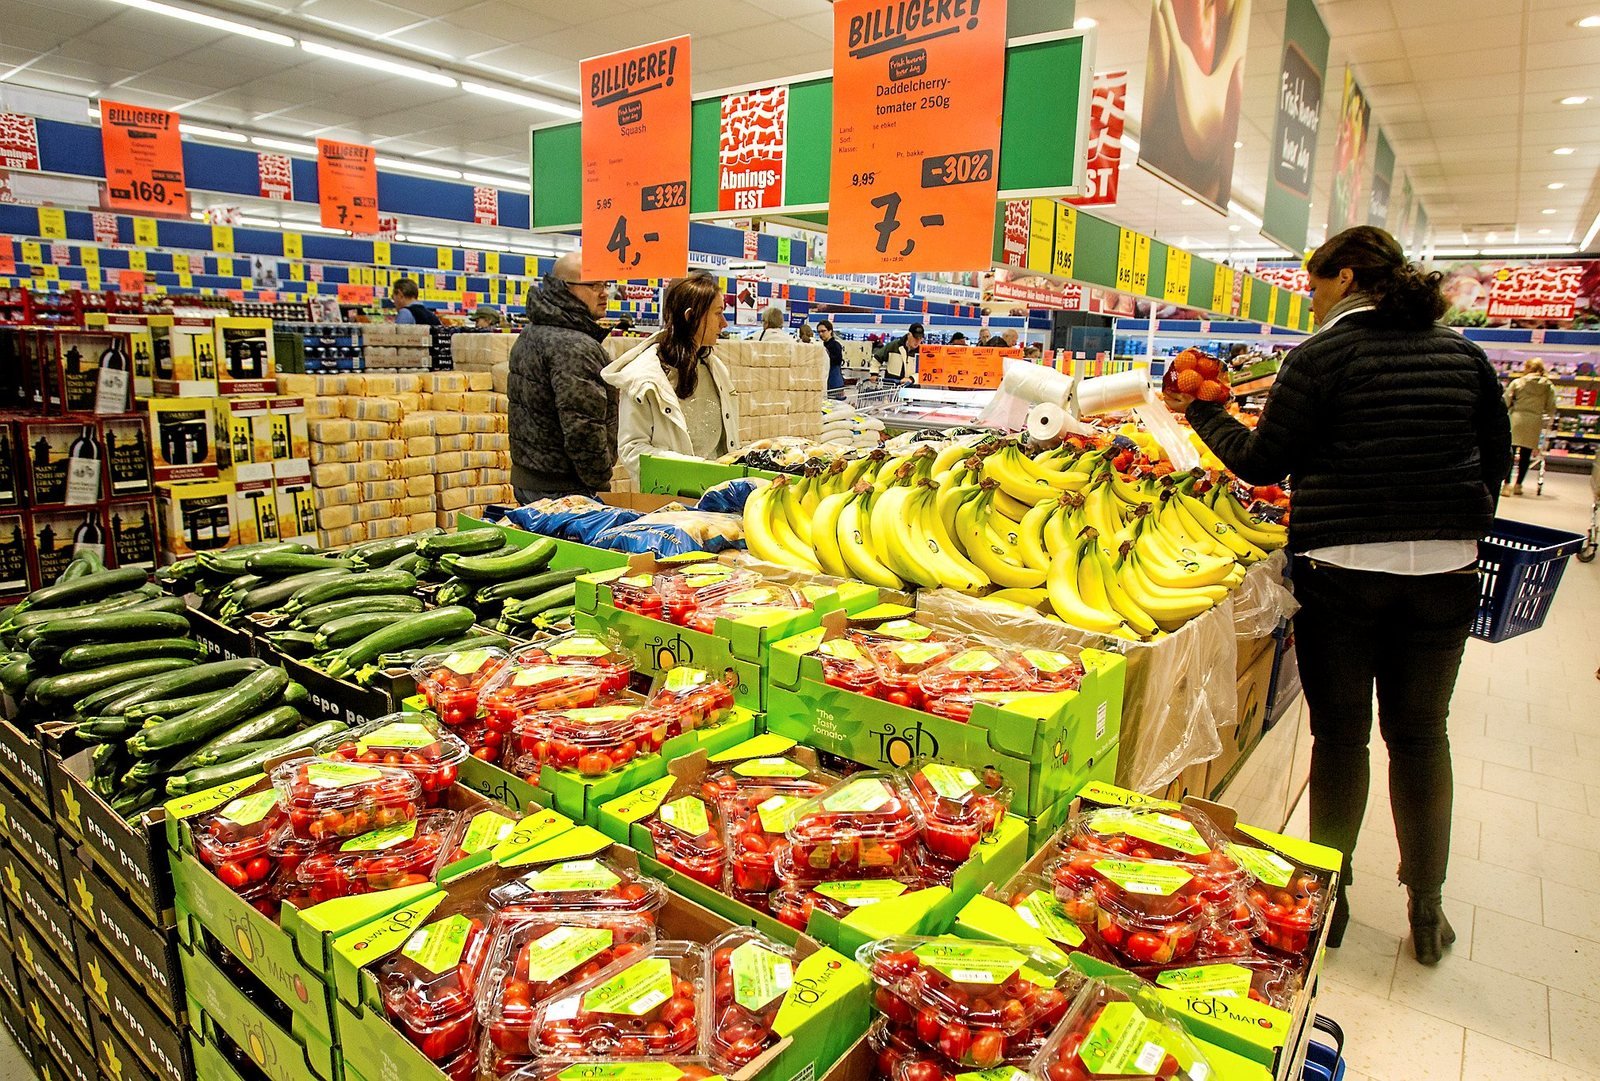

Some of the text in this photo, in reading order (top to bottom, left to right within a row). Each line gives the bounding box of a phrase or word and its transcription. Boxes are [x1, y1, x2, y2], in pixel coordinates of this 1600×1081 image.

[849, 0, 980, 48] BILLIGERE!
[591, 46, 677, 98] BILLIGERE!
[876, 78, 951, 97] Daddelcherry-
[876, 95, 950, 115] tomater 250g
[109, 108, 170, 130] BILLIGERE!
[620, 124, 647, 137] Squash
[6, 158, 27, 169] FEST
[931, 154, 988, 184] -30%
[721, 168, 780, 191] Åbnings-
[852, 172, 875, 187] 9,95
[1085, 167, 1113, 199] ST
[130, 180, 184, 206] 169,-
[647, 185, 684, 208] -33%
[734, 189, 765, 210] FEST
[1057, 249, 1072, 269] 13,95
[1062, 297, 1079, 308] EST
[308, 692, 340, 714] epo
[815, 717, 838, 731] Tasty
[20, 758, 44, 787] pepo
[10, 816, 59, 870] pepo pepo
[87, 815, 150, 888] pepo pepo
[25, 891, 74, 952] pepo pepo
[100, 908, 167, 987] pepo pepo
[63, 993, 88, 1028] pepo
[114, 996, 182, 1081] pepo pepo
